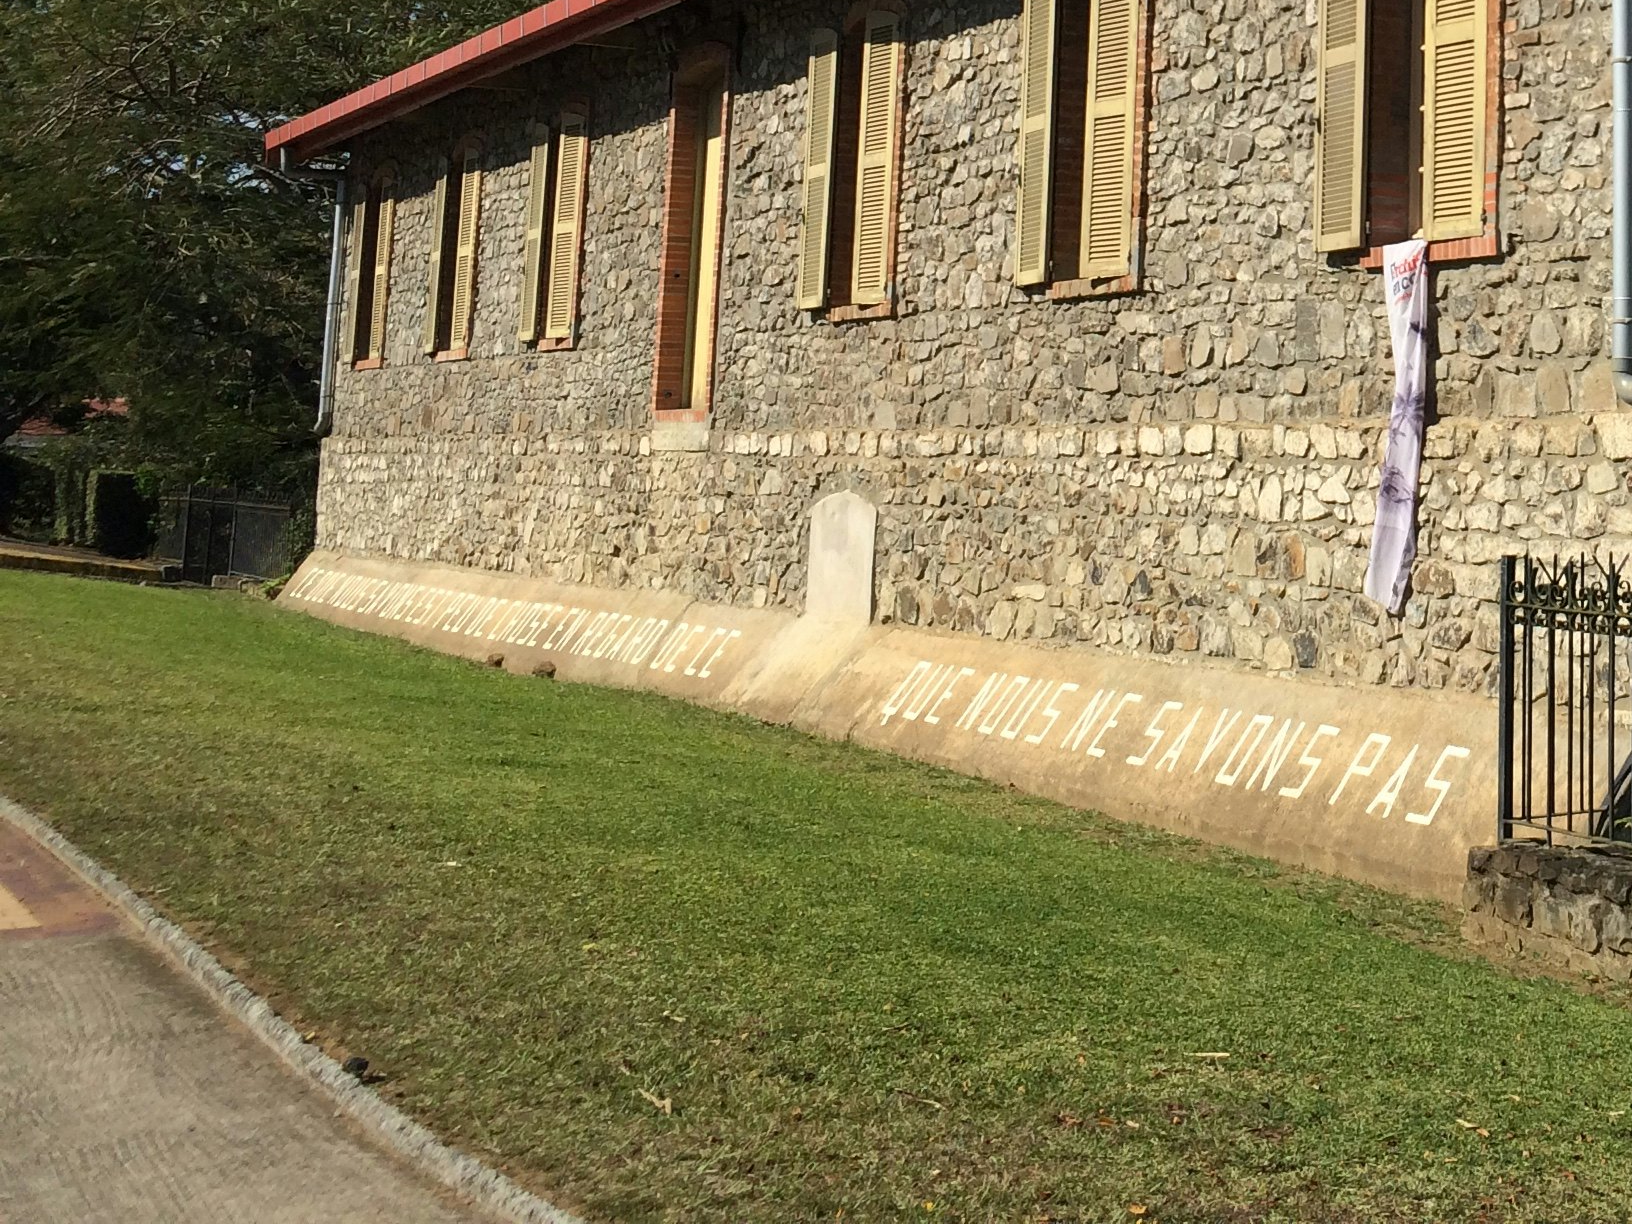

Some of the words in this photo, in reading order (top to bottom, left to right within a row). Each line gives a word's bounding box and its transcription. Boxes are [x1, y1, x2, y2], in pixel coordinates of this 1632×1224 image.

[290, 567, 325, 598] CE
[327, 575, 379, 611] NOUS
[486, 600, 564, 648] CHOSE
[542, 607, 592, 652] EN
[570, 611, 669, 665] REGARD
[649, 621, 706, 673] DE
[684, 627, 743, 679] CE
[880, 660, 975, 727] QUE
[955, 671, 1080, 745] NOUS
[1060, 689, 1144, 759] NE
[1125, 700, 1342, 799] SAVONS
[1328, 732, 1472, 826] PAS
